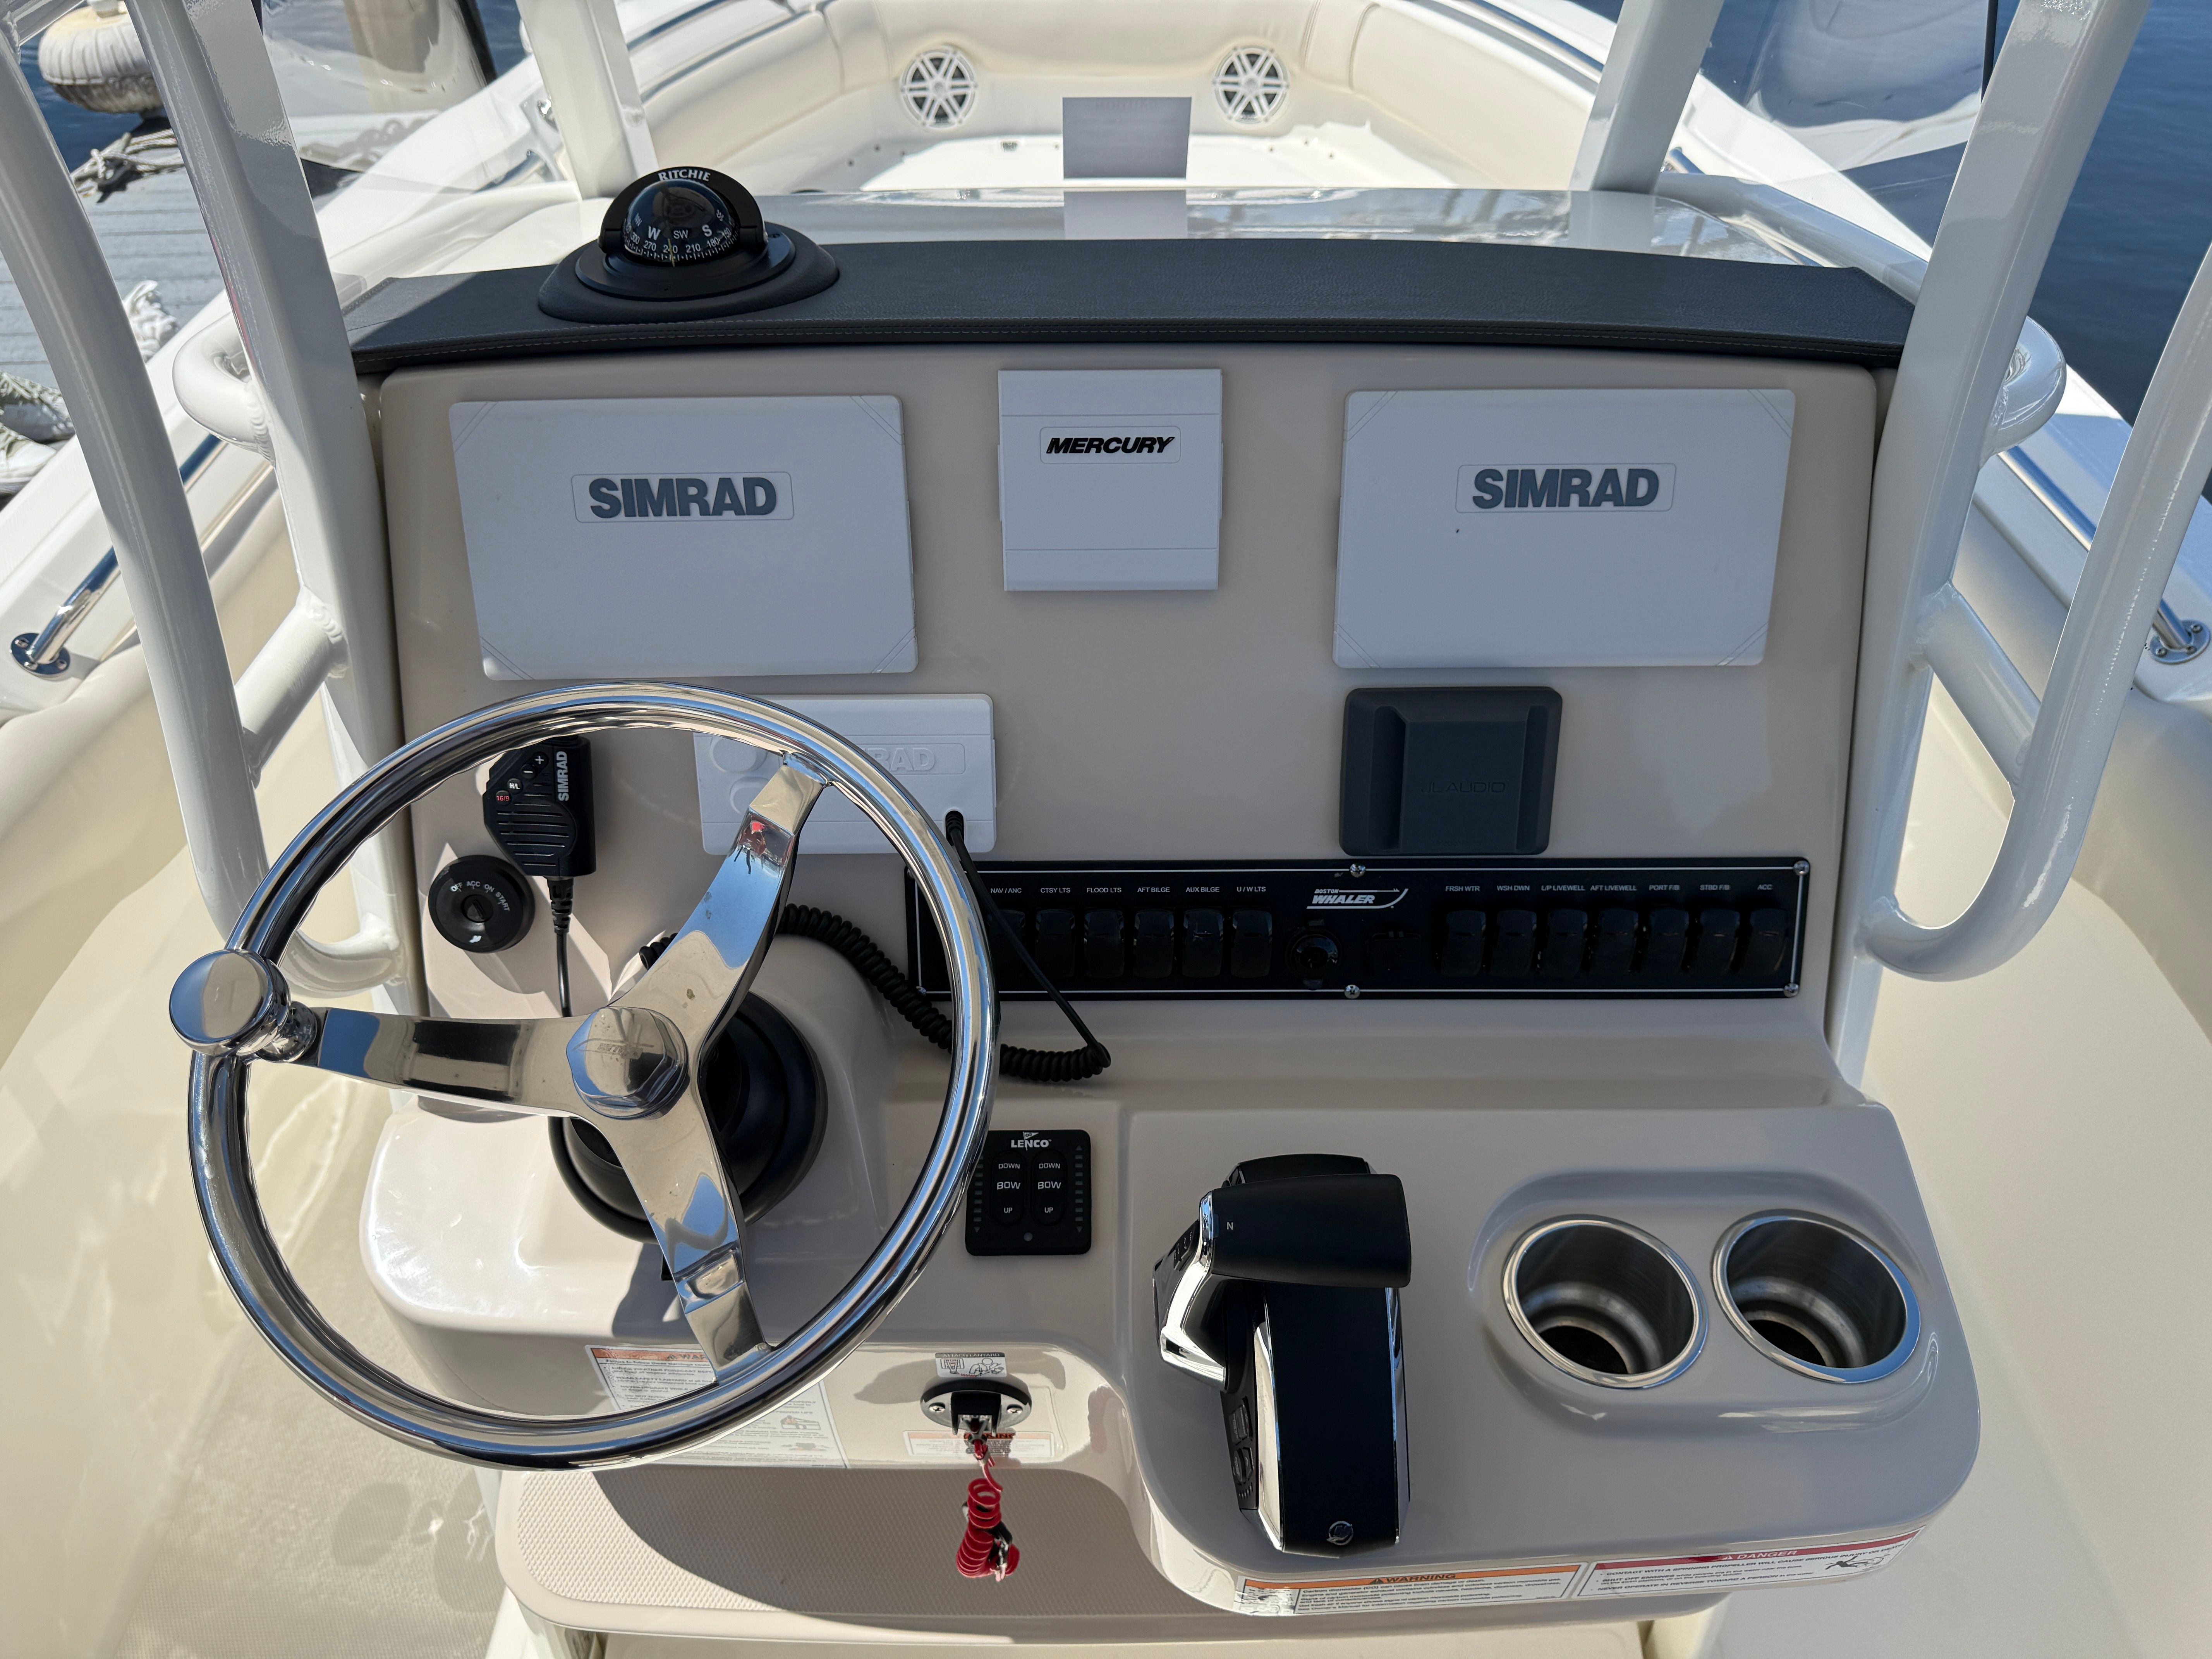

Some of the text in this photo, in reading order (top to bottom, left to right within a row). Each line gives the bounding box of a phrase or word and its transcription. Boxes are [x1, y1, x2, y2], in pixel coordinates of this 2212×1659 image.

[658, 169, 711, 182] RITCHIE
[648, 225, 661, 240] W
[673, 229, 688, 239] SW
[702, 224, 712, 237] S
[643, 240, 656, 251] 270
[685, 243, 701, 253] 210
[707, 237, 720, 248] 180
[1046, 436, 1175, 454] MERCURY
[1472, 469, 1659, 509] SIMRAD
[589, 477, 777, 519] SIMRAD
[867, 747, 936, 772] RAD
[556, 751, 569, 802] SIMRAD
[1446, 782, 1506, 793] AUDIO
[450, 882, 463, 892] OFF
[484, 884, 495, 892] ON
[496, 892, 510, 911] START
[1312, 895, 1376, 904] WHALER
[1011, 1139, 1049, 1148] LENCO
[997, 1181, 1020, 1190] BOW
[1038, 1181, 1061, 1189] BOW
[1226, 1222, 1234, 1230] N
[1736, 1550, 1797, 1560] DANGER
[1386, 1573, 1456, 1583] WARNING
